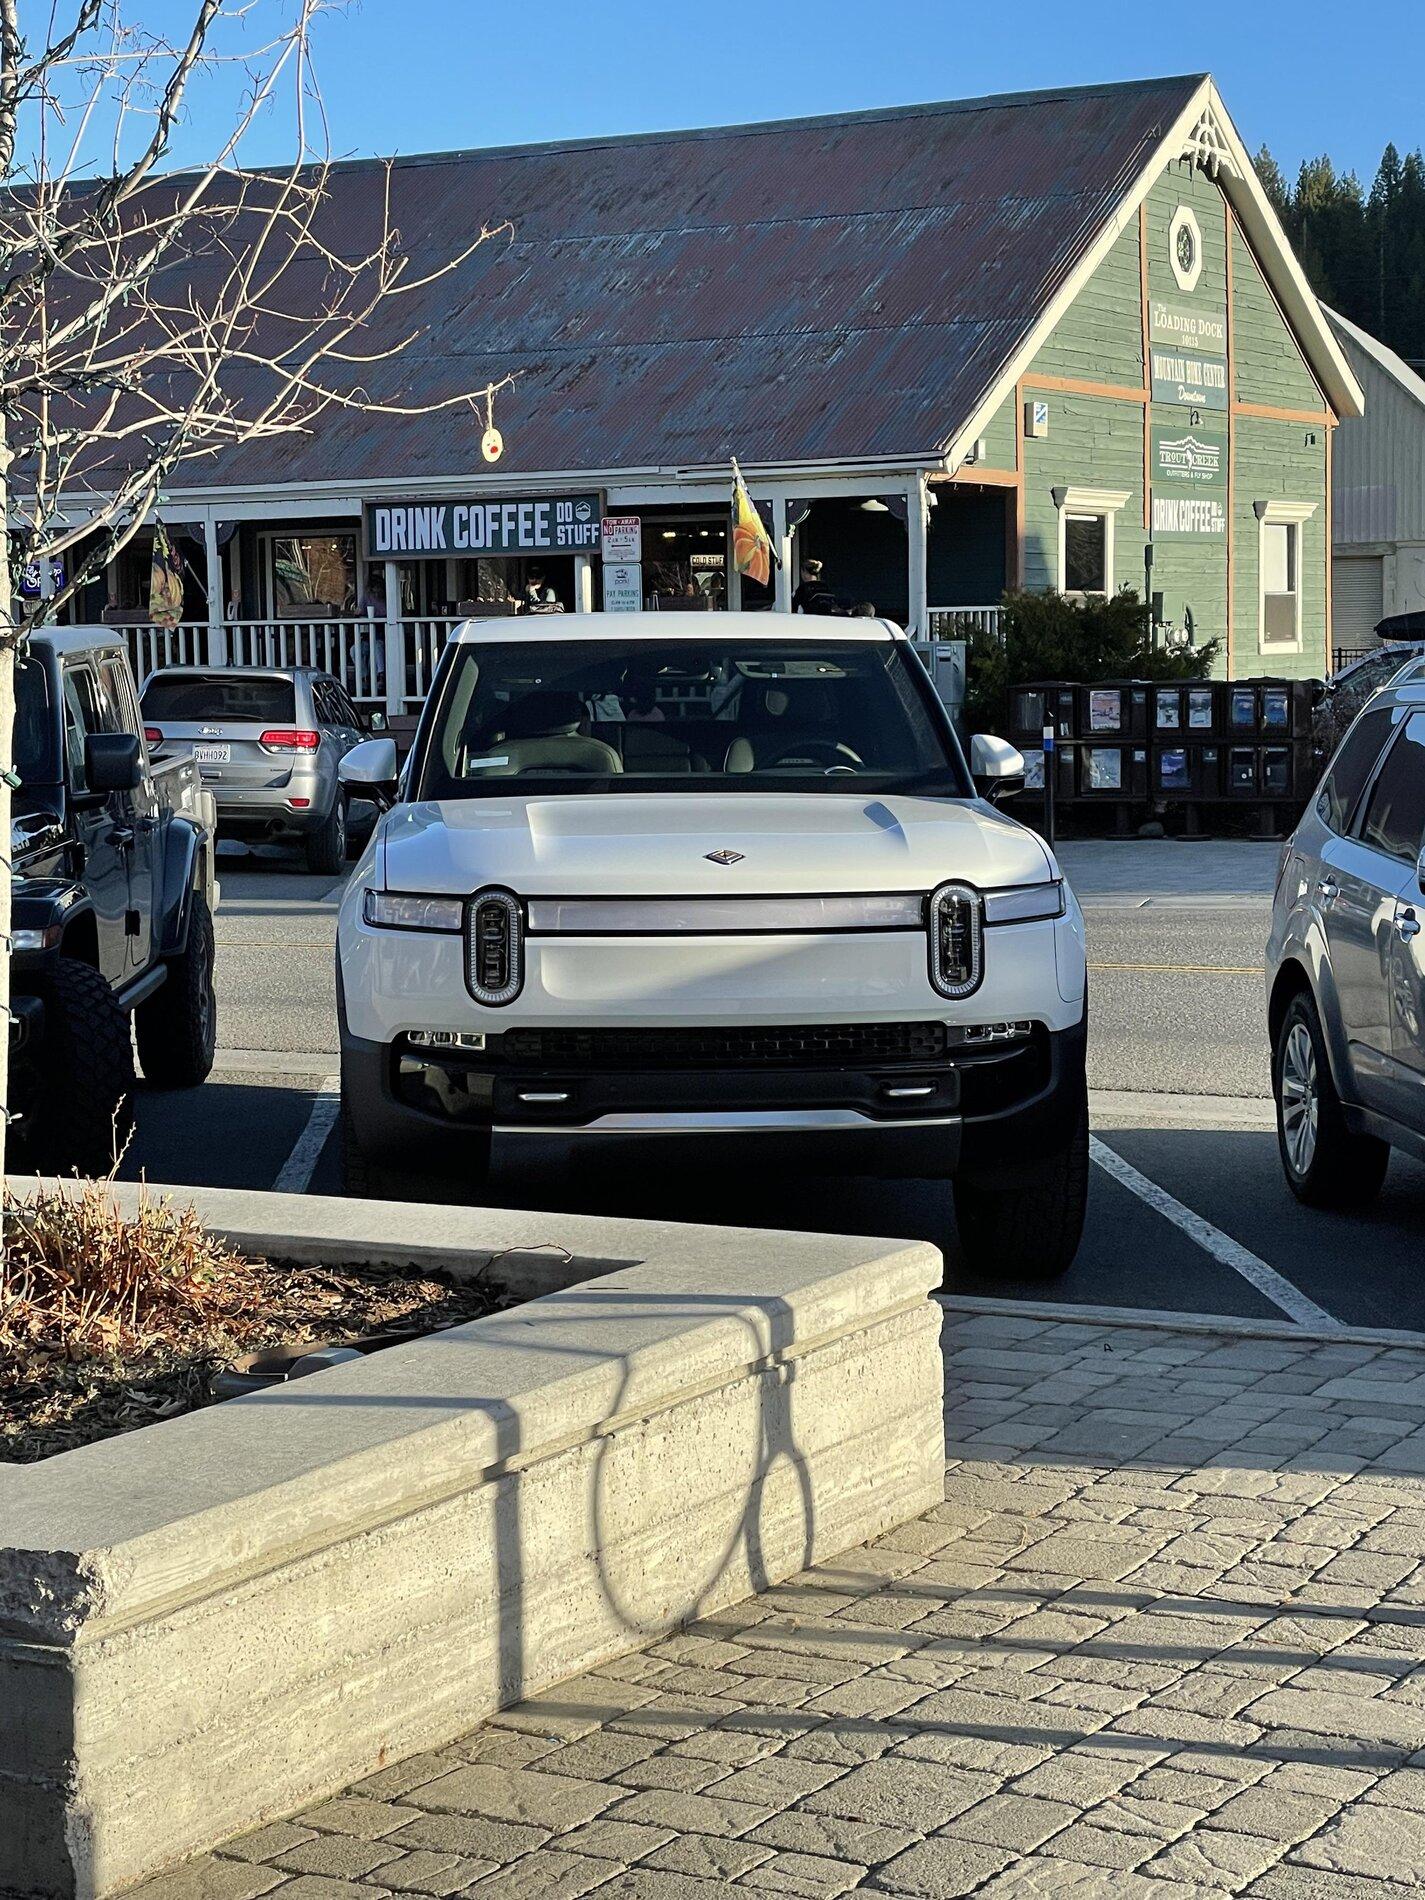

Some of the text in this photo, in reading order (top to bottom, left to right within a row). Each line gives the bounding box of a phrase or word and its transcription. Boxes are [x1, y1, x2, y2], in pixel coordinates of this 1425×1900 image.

[1154, 310, 1223, 339] LOADING DOCK
[1153, 355, 1186, 383] MOUNTAIN
[1203, 362, 1226, 389] CENTER
[1159, 450, 1220, 467] TROUT CREEK
[1201, 472, 1214, 480] SHOP
[556, 501, 573, 523] DO
[1153, 498, 1211, 532] DRINK COFFEE
[375, 502, 551, 552] DRINK COFFEE
[556, 523, 600, 546] STUFF
[603, 525, 638, 535] NO PARKING
[692, 556, 707, 565] COLD
[617, 590, 638, 598] PARKING
